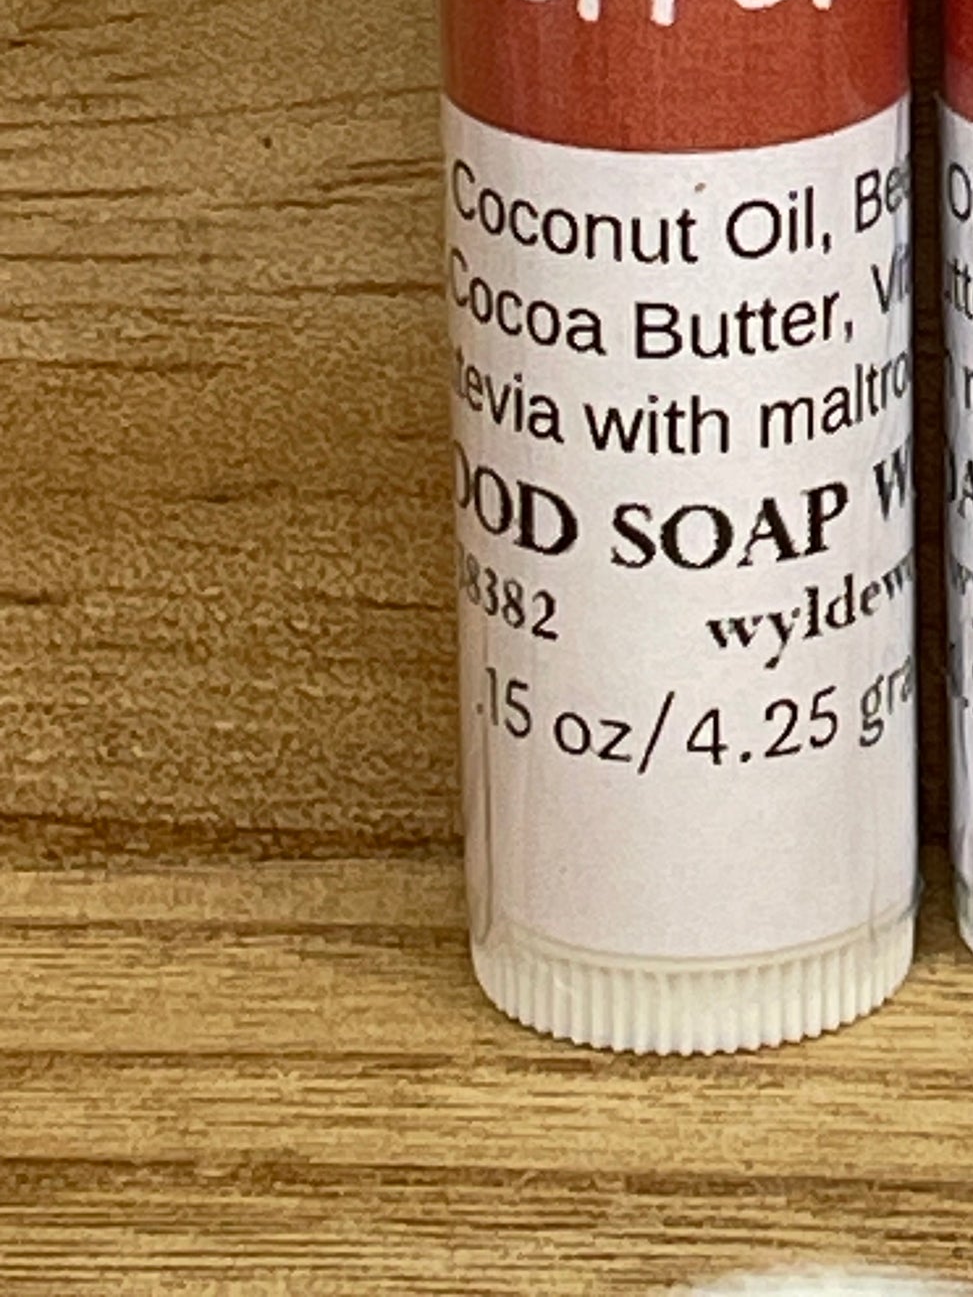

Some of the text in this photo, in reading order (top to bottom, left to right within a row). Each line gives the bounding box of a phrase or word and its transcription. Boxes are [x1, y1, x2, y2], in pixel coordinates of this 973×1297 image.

[453, 159, 698, 264] Coconut
[726, 186, 831, 259] Oil,
[450, 247, 607, 355] Cocoa
[635, 291, 853, 359] Butter,
[584, 395, 730, 454] with
[610, 481, 848, 569] SOAP
